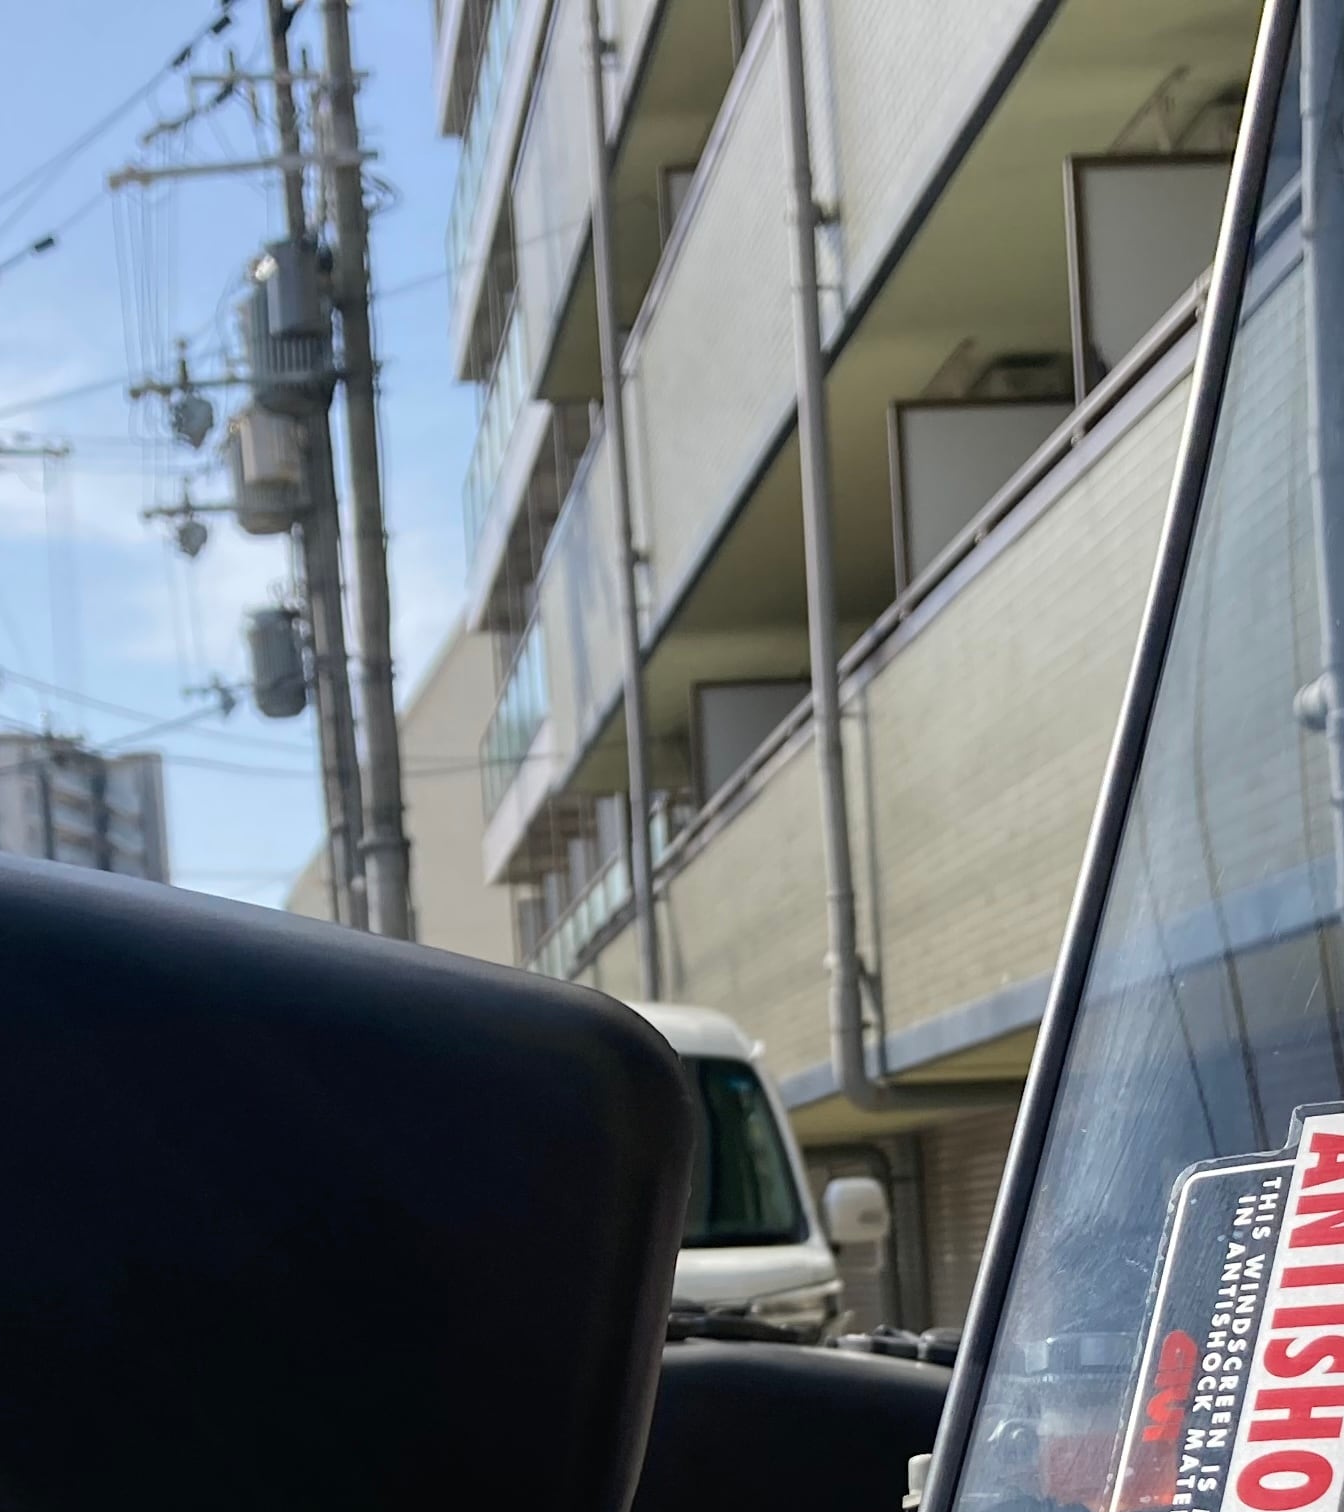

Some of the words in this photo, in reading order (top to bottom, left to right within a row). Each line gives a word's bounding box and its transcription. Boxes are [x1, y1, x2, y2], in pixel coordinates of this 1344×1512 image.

[1231, 1192, 1258, 1227] IN
[1250, 1175, 1283, 1240] THIS
[1190, 1240, 1247, 1413] ANTISHOCK
[1204, 1252, 1266, 1449] WINDSCREEN
[1195, 1463, 1221, 1493] IS
